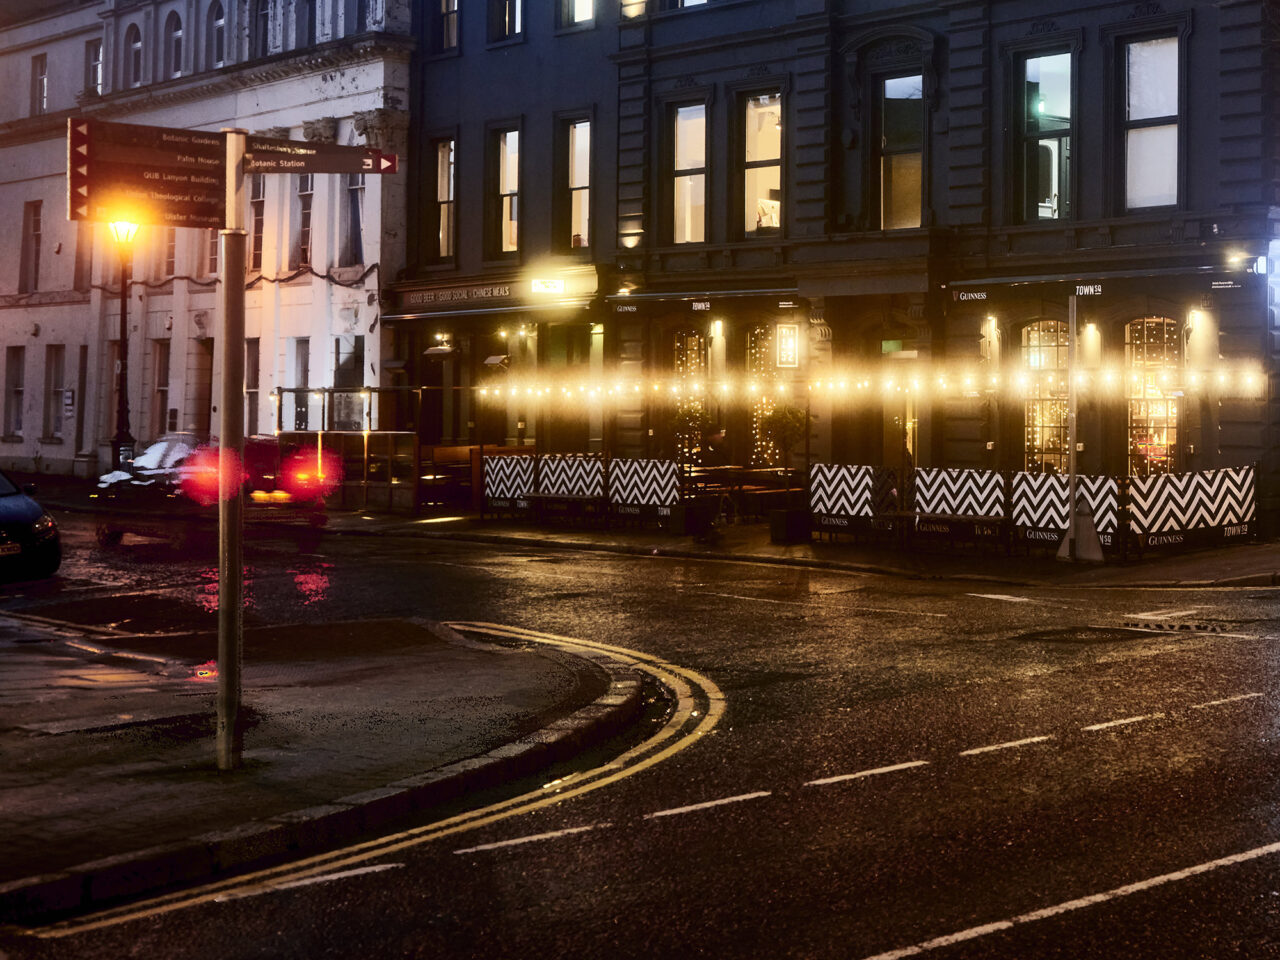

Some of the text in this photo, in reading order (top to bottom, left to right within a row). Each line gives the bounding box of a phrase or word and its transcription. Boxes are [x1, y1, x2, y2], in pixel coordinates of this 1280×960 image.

[250, 159, 305, 168] Botanic Station
[960, 291, 987, 301] GUINNESS
[821, 516, 849, 527] GUINNESS
[919, 522, 950, 534] GUINNESS
[1026, 528, 1059, 542] GUINNESS
[1148, 534, 1184, 547] GUINNESS
[1224, 526, 1241, 538] TOWN
